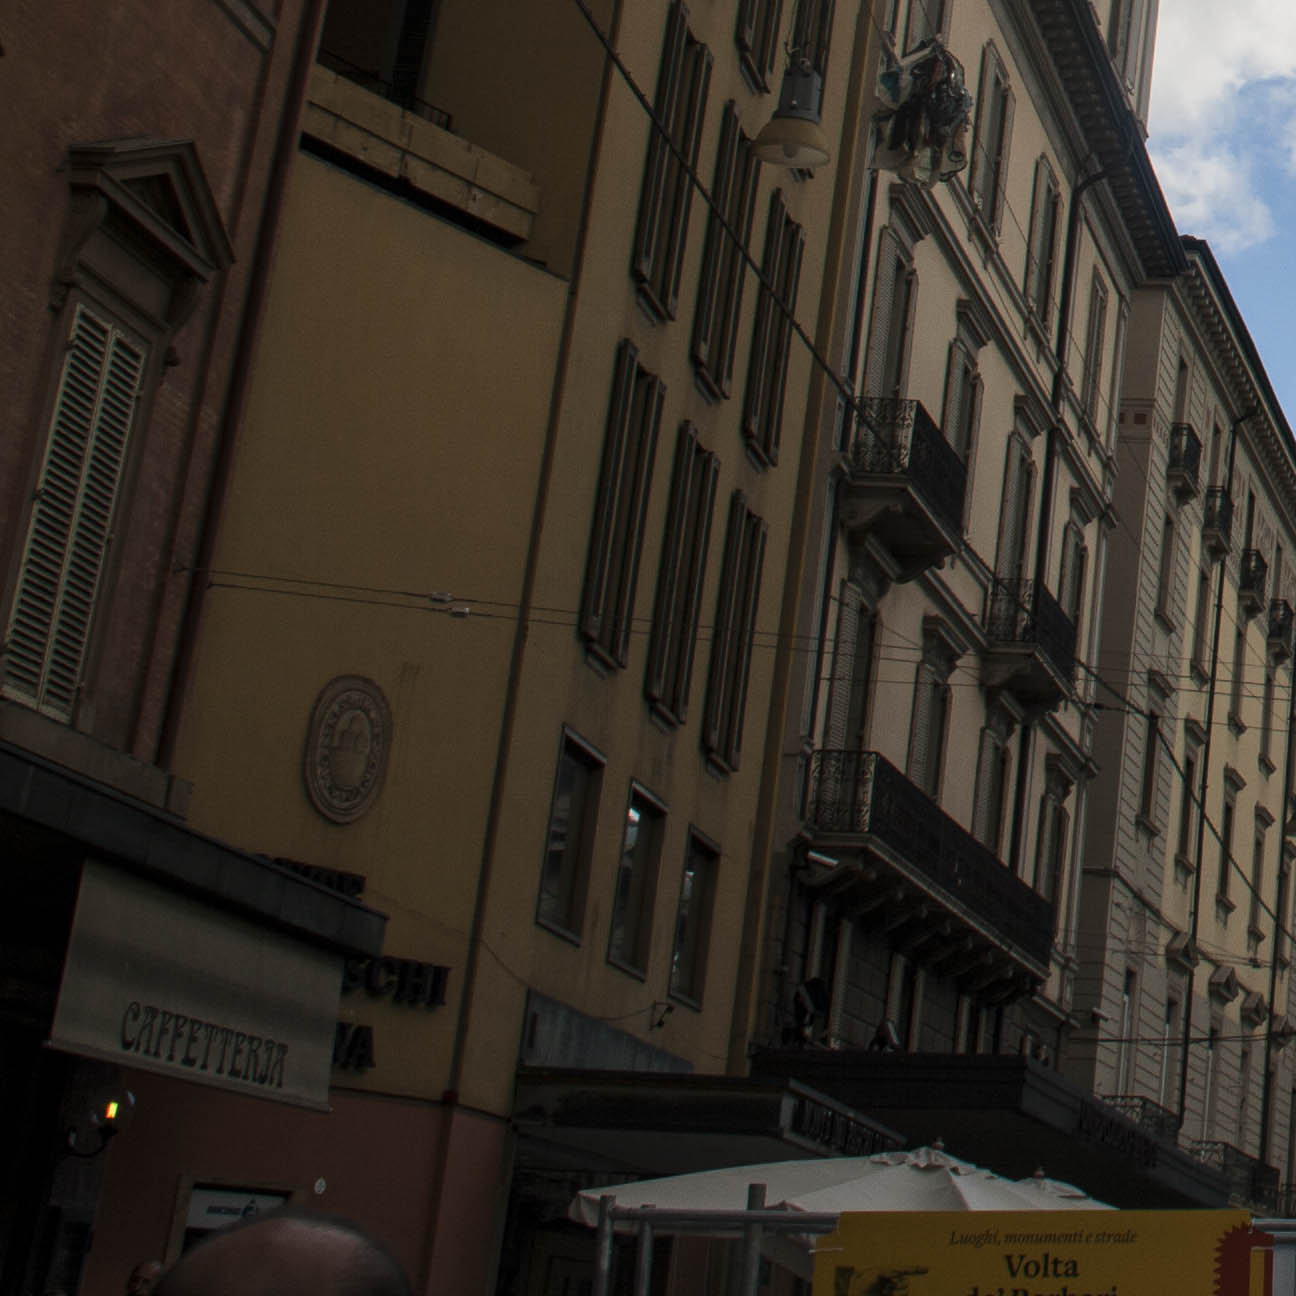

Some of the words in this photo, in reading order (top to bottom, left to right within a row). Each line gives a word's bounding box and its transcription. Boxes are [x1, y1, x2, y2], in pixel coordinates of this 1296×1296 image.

[950, 1230, 1000, 1248] Luoghi,
[1004, 1230, 1083, 1244] monumenti
[1096, 1230, 1137, 1244] strade
[1003, 1253, 1079, 1278] Volta
